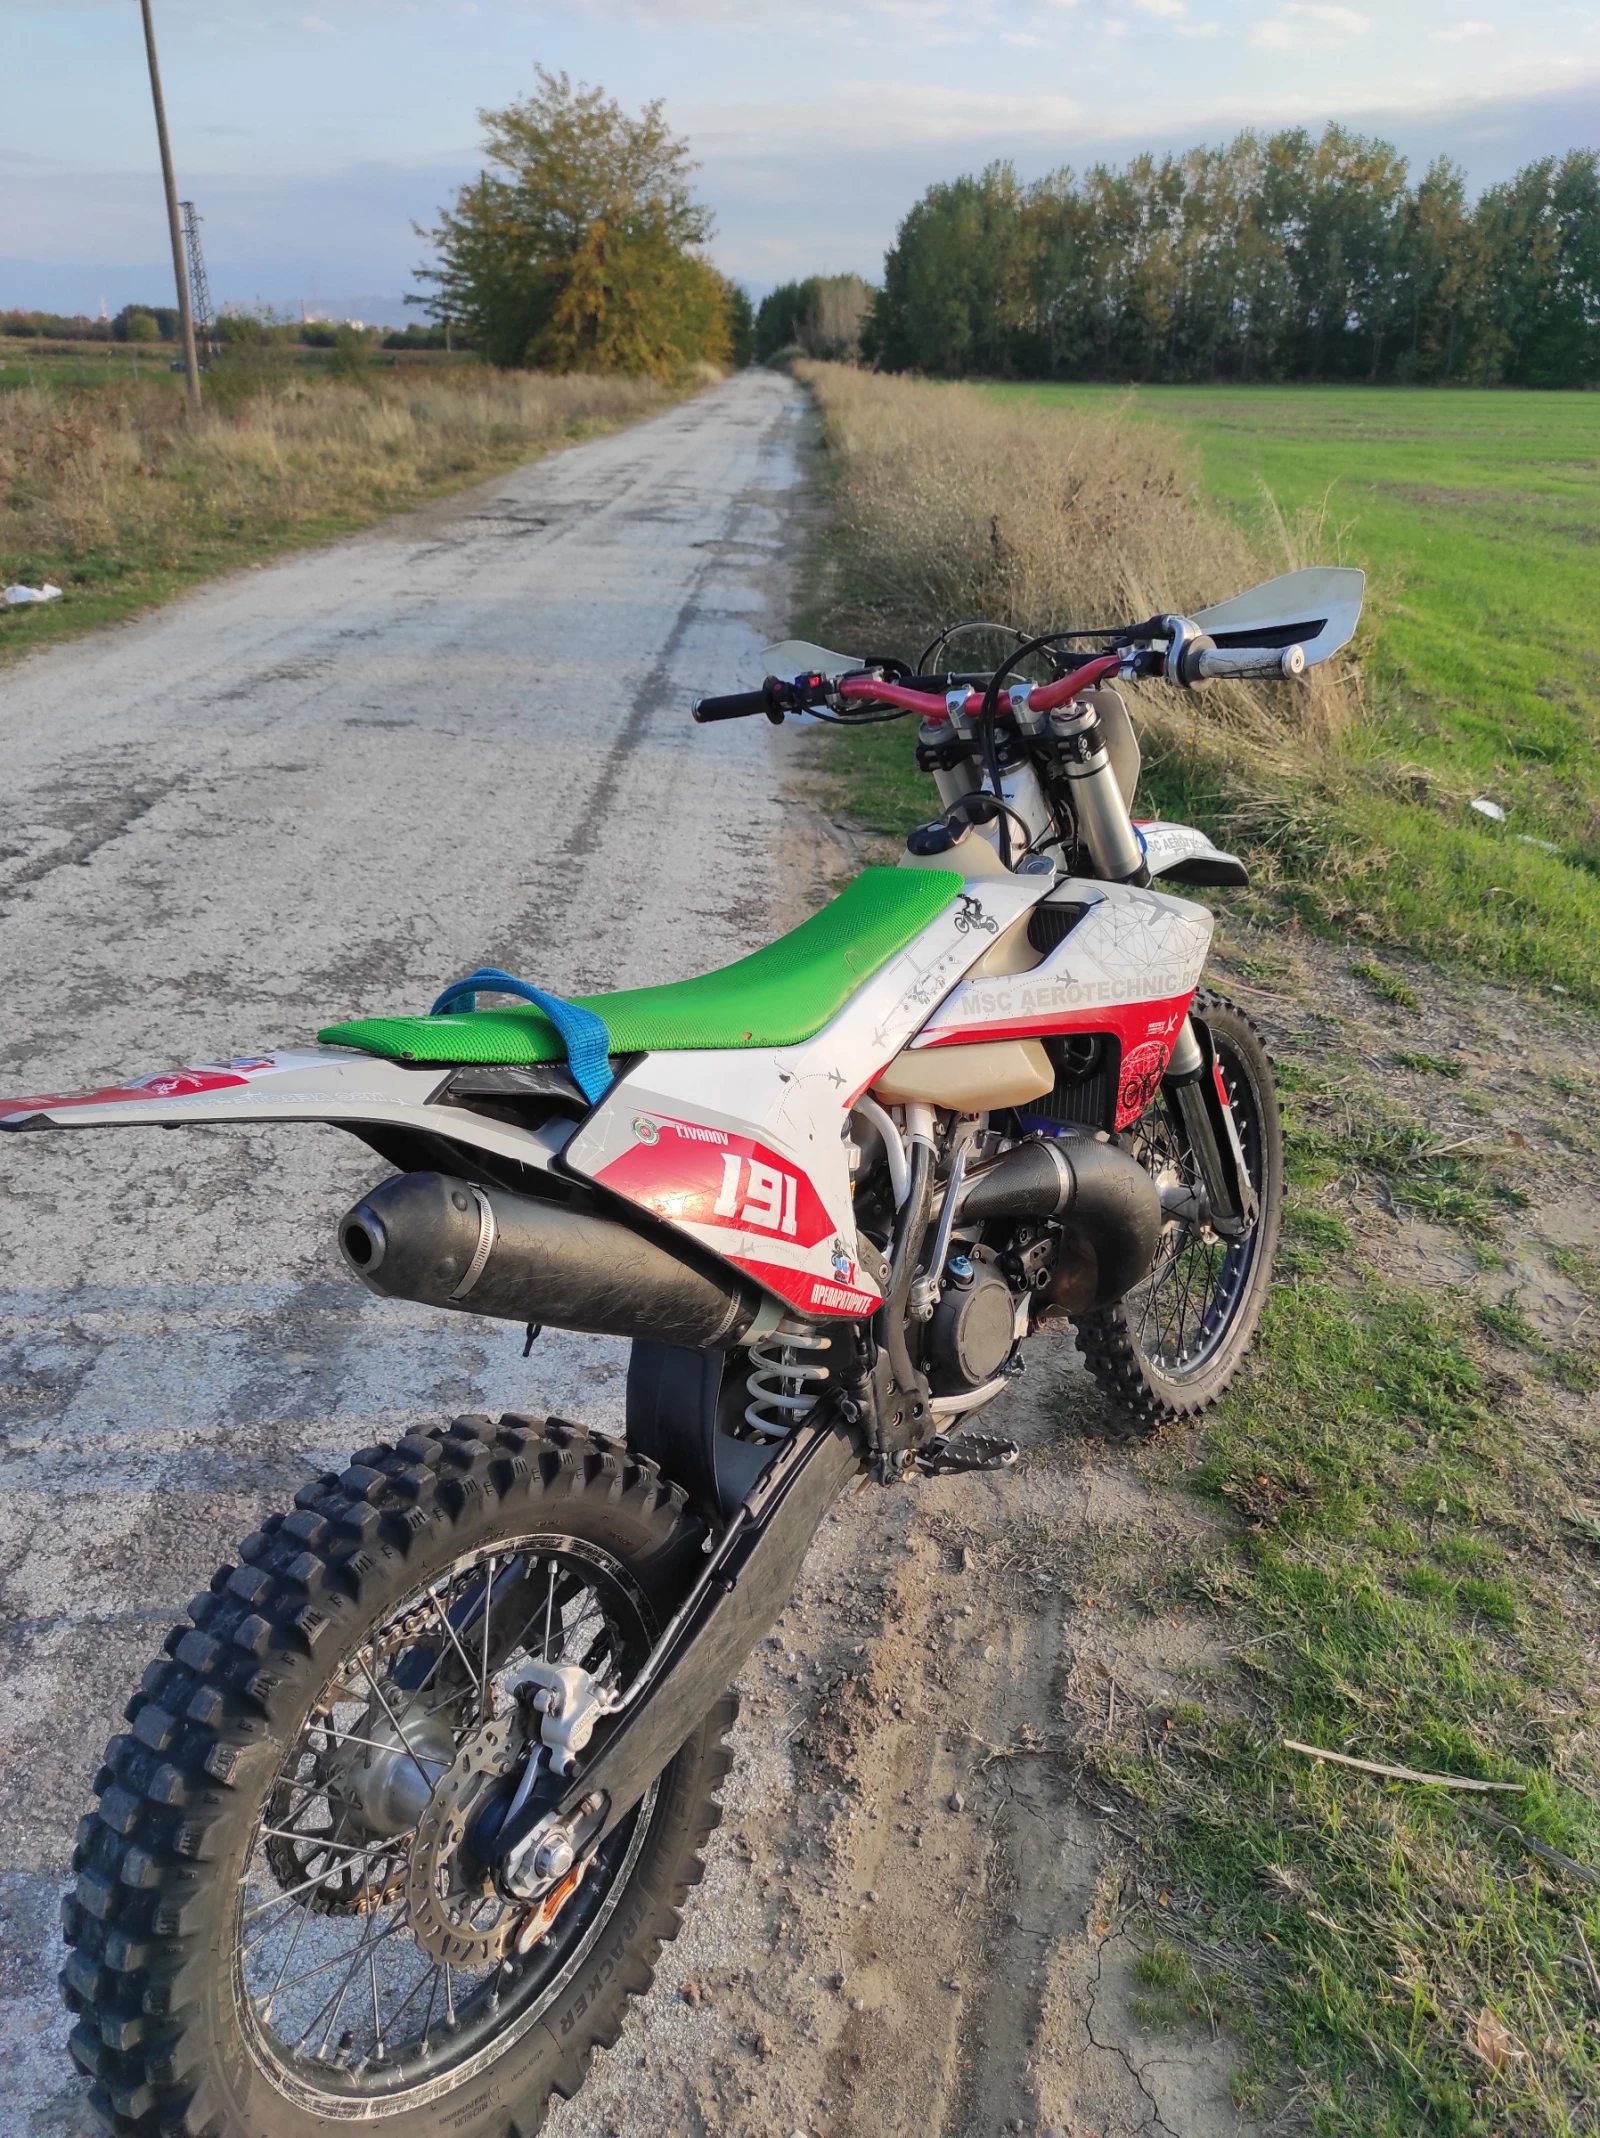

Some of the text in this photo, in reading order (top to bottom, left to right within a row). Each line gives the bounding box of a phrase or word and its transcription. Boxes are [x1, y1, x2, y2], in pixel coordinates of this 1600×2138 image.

[1148, 839, 1161, 852] SC
[962, 992, 1012, 1016] MSC
[1020, 974, 1178, 1009] AEROTECHNIC
[713, 1152, 798, 1236] 191
[559, 1900, 648, 2036] TRACKER
[454, 2102, 489, 2129] MICHELIN
